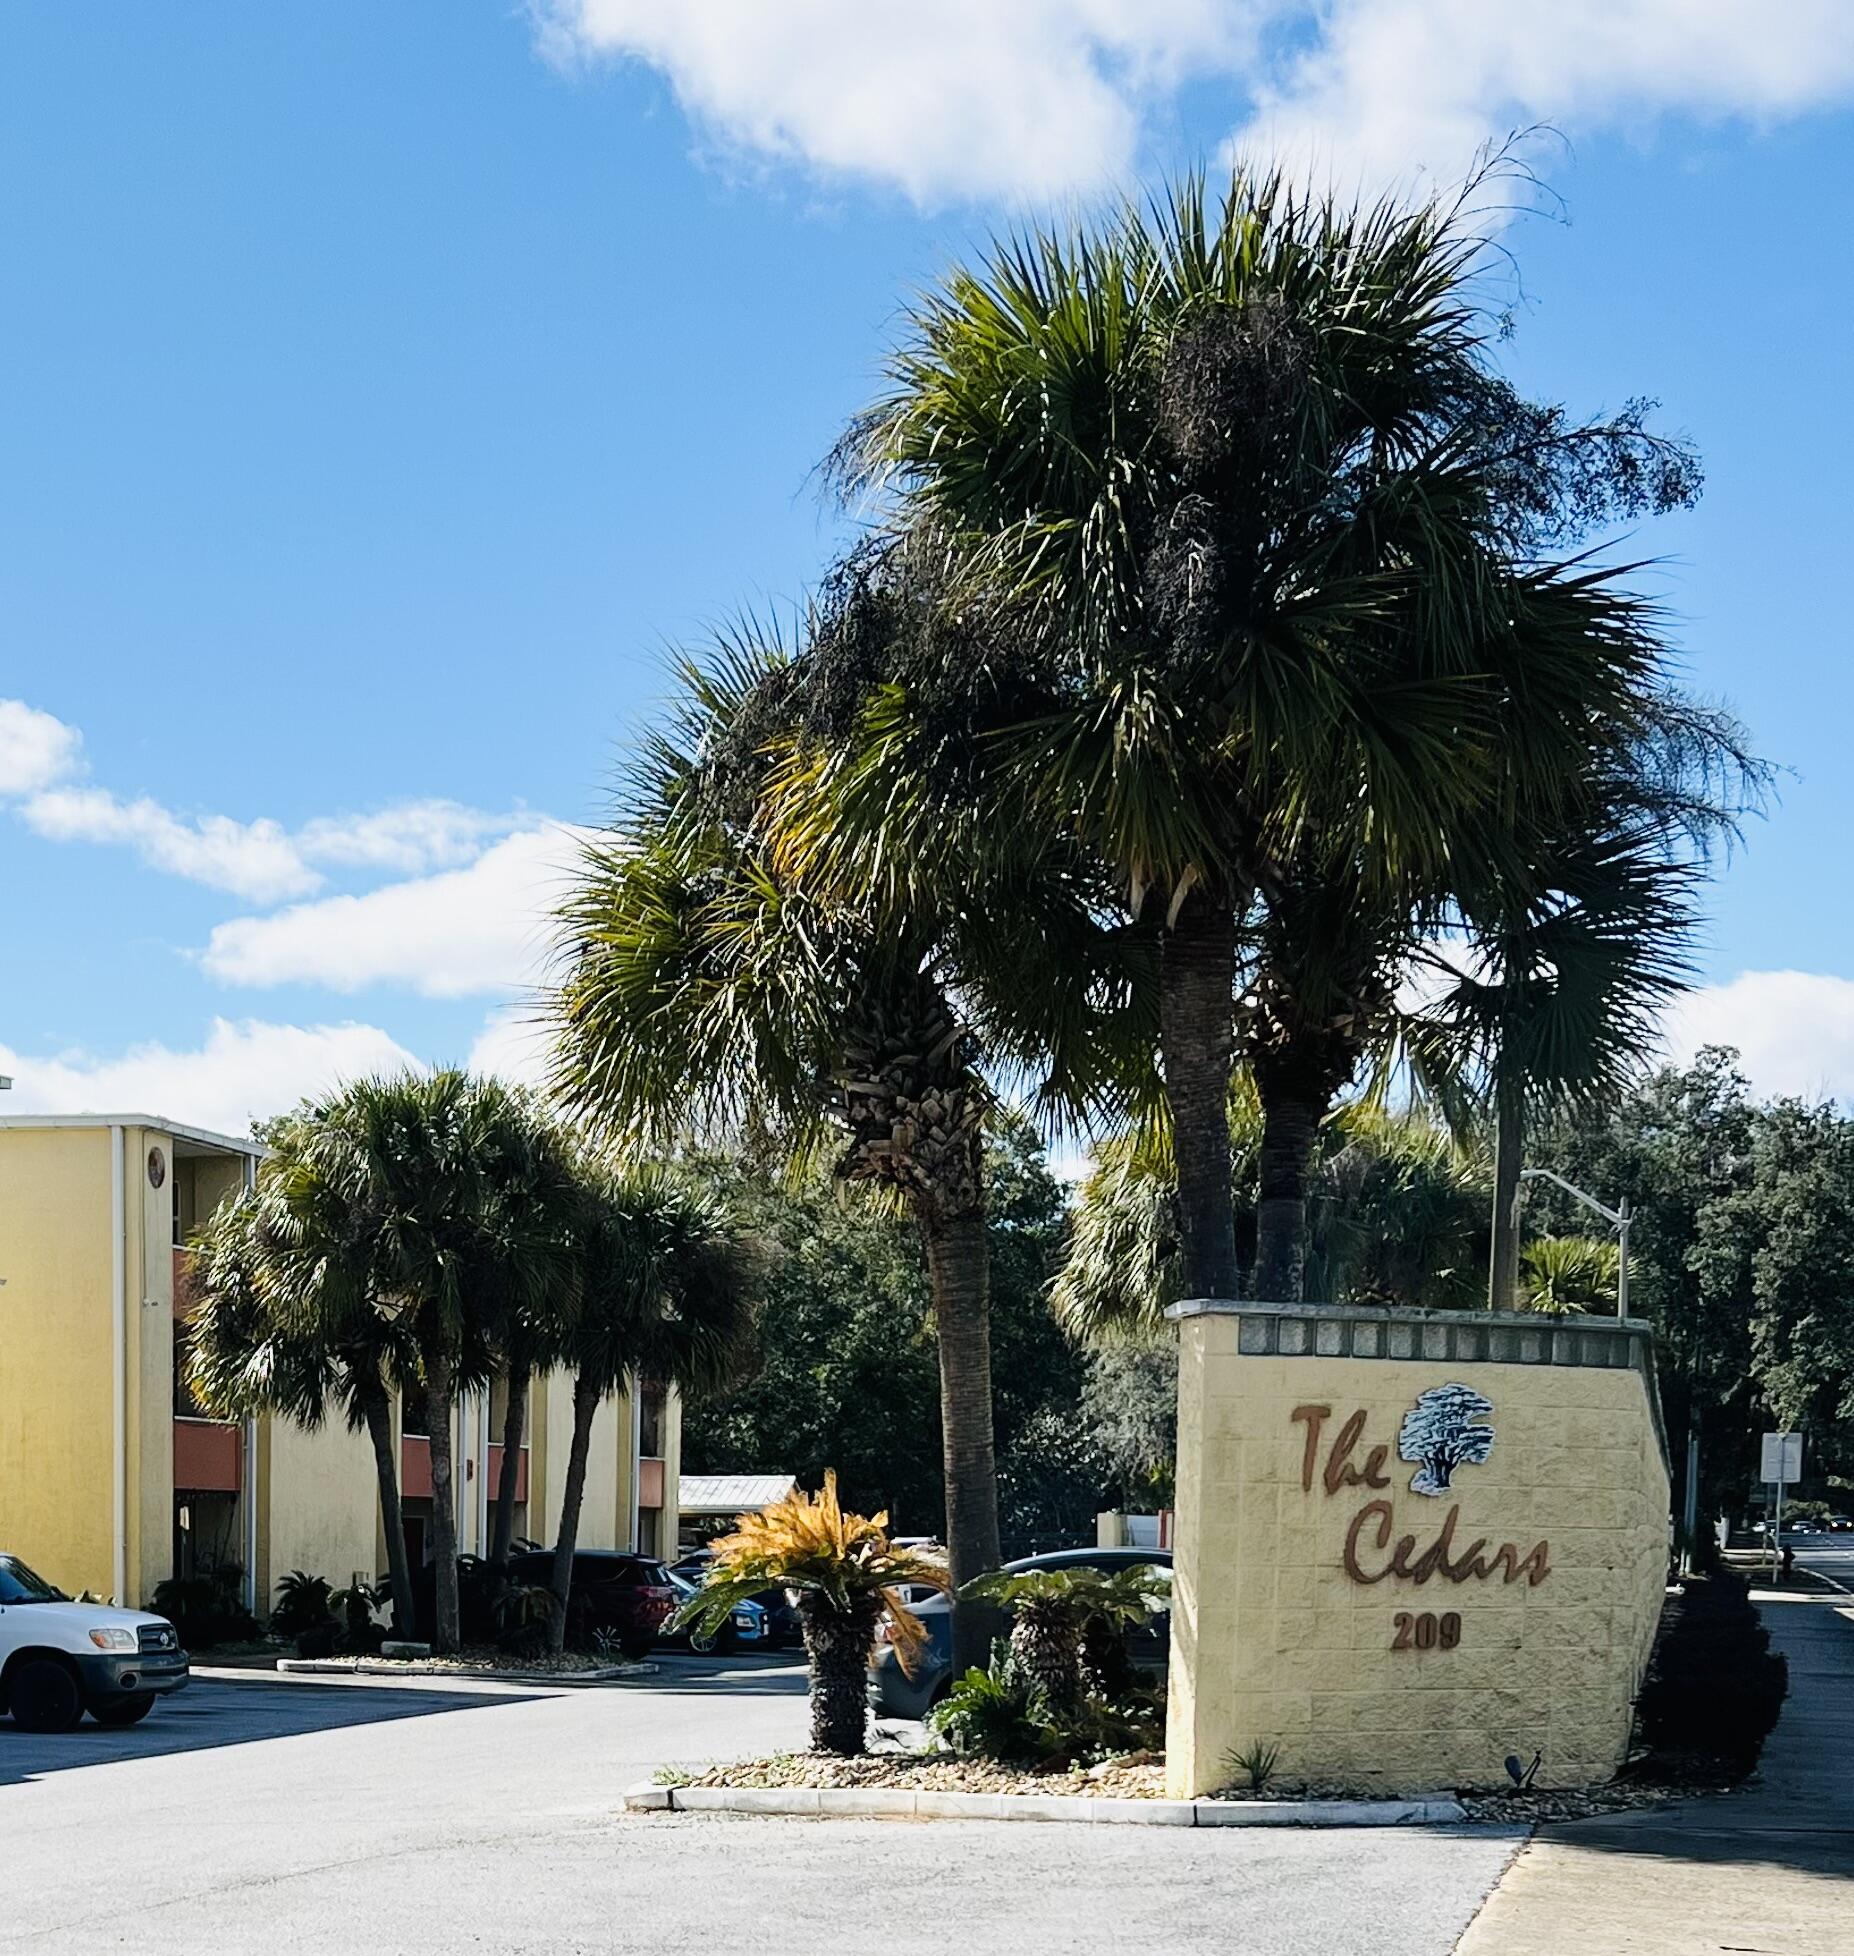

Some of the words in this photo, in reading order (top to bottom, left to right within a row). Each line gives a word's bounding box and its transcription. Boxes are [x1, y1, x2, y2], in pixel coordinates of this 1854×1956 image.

[1291, 1406, 1390, 1494] The
[1345, 1501, 1550, 1586] Cedars
[1392, 1612, 1461, 1650] 209
